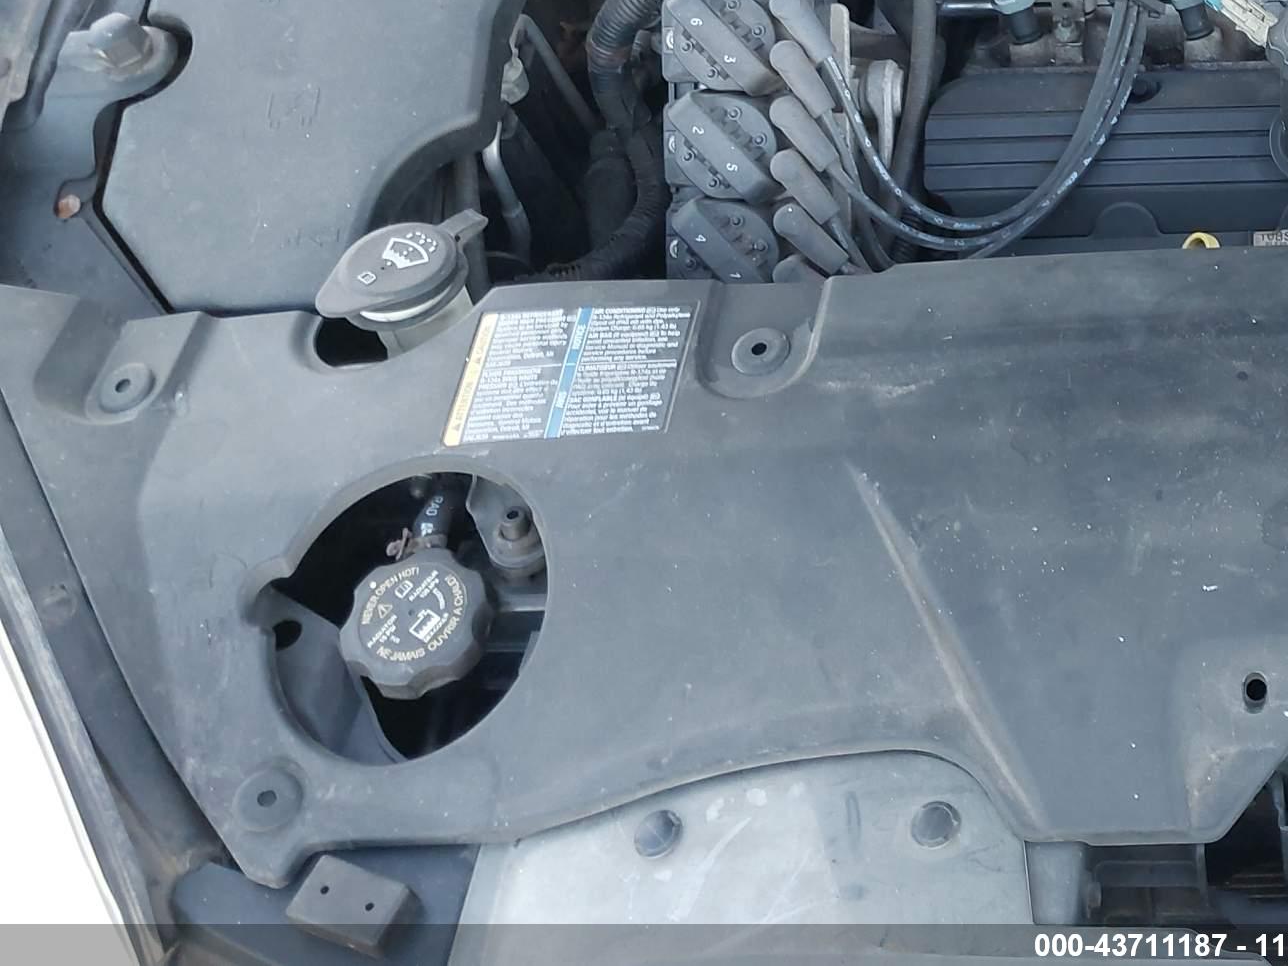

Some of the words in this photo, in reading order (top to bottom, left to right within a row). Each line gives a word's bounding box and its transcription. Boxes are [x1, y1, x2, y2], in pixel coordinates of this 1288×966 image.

[690, 17, 703, 27] 6
[724, 54, 737, 64] 3
[692, 126, 704, 136] 2
[726, 162, 738, 173] 5
[695, 235, 708, 243] 4
[375, 577, 397, 597] OPEN
[376, 645, 391, 660] NE
[389, 648, 426, 663] JAMAIS
